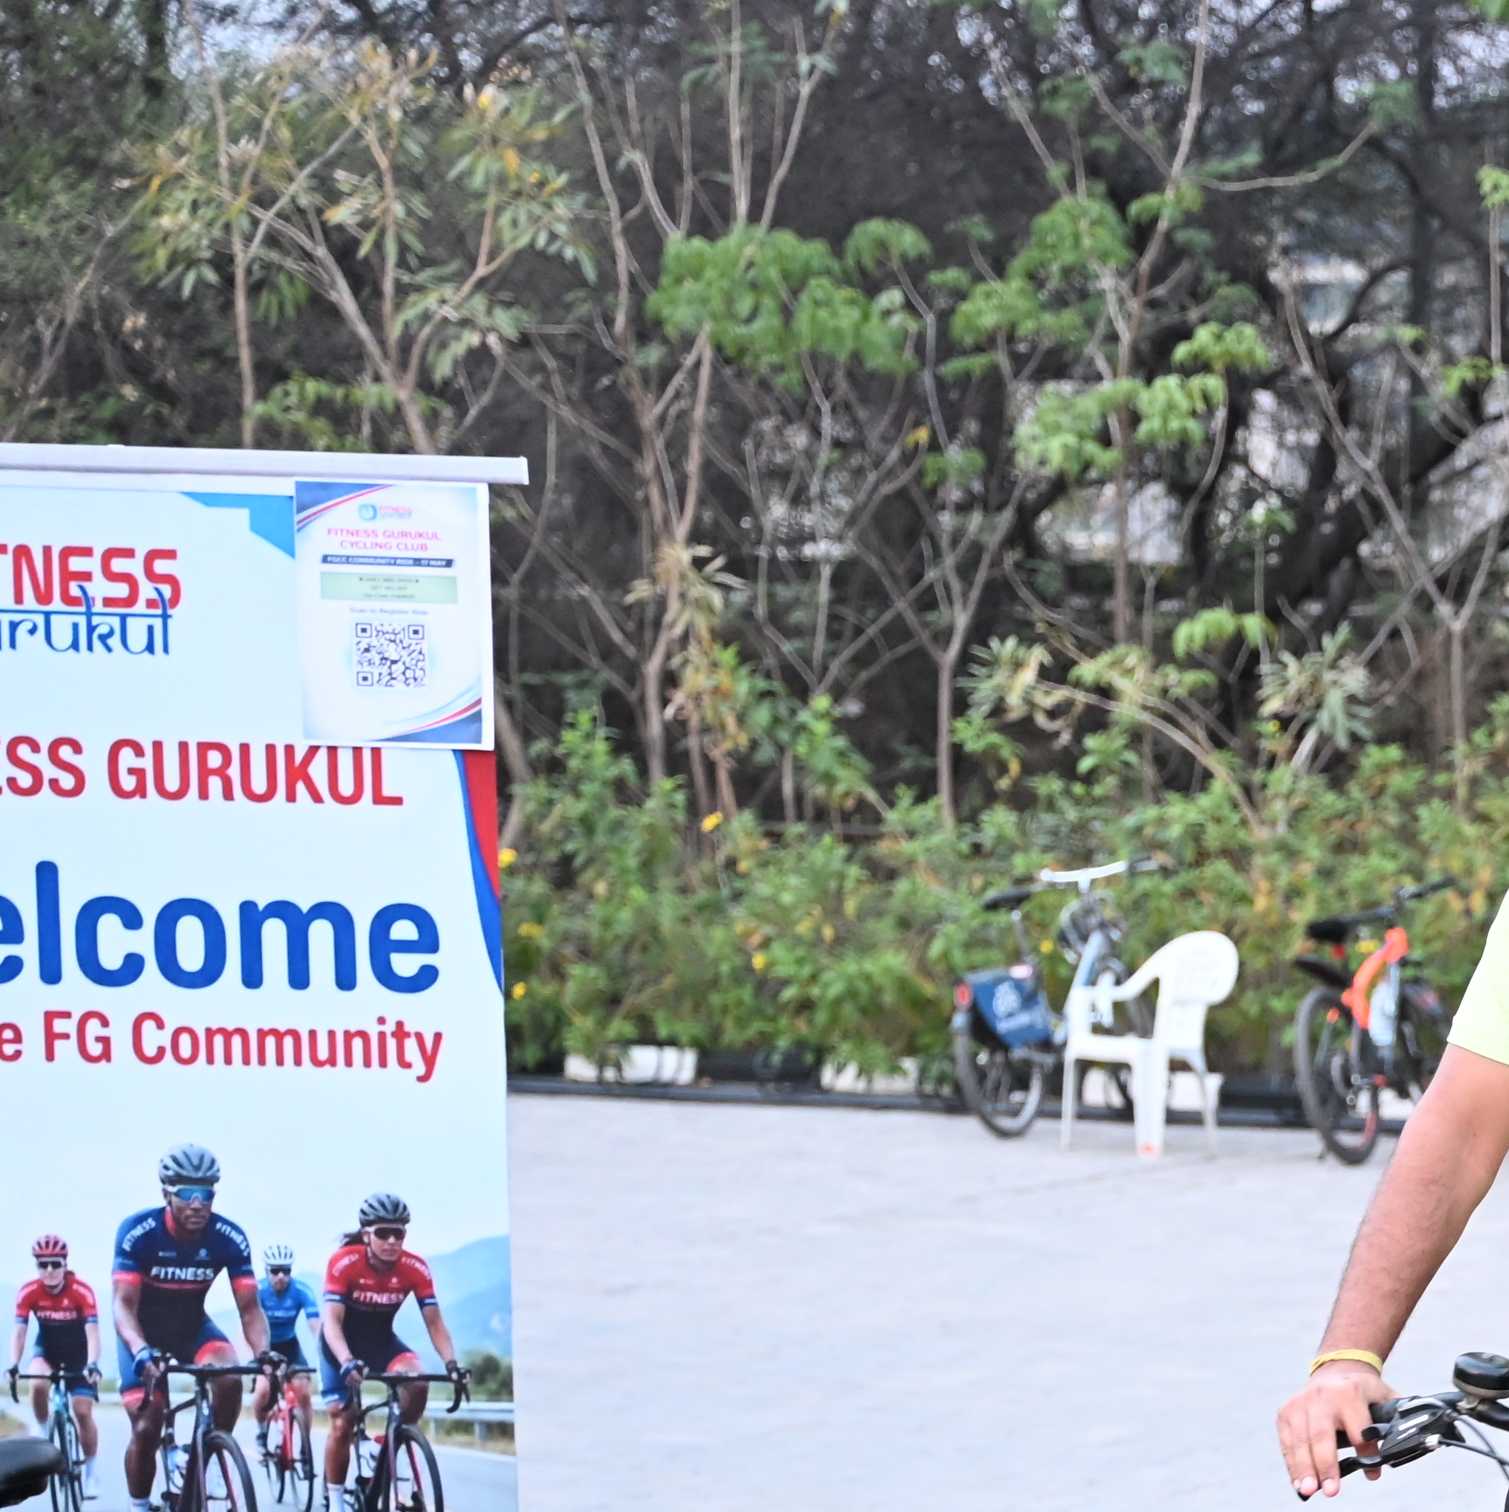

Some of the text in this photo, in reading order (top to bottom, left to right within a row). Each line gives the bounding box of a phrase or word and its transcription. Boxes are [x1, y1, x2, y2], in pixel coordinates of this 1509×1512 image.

[327, 528, 441, 541] FITNESS GURUKUL
[340, 540, 428, 551] CYCLING CLUB
[0, 544, 181, 610] NESS
[0, 584, 172, 656] rukul
[0, 736, 403, 806] SS GURUKUL
[44, 1010, 112, 1063] FG
[131, 1012, 443, 1083] Community
[150, 1266, 215, 1281] FITNESS
[352, 1290, 405, 1305] FITNESS
